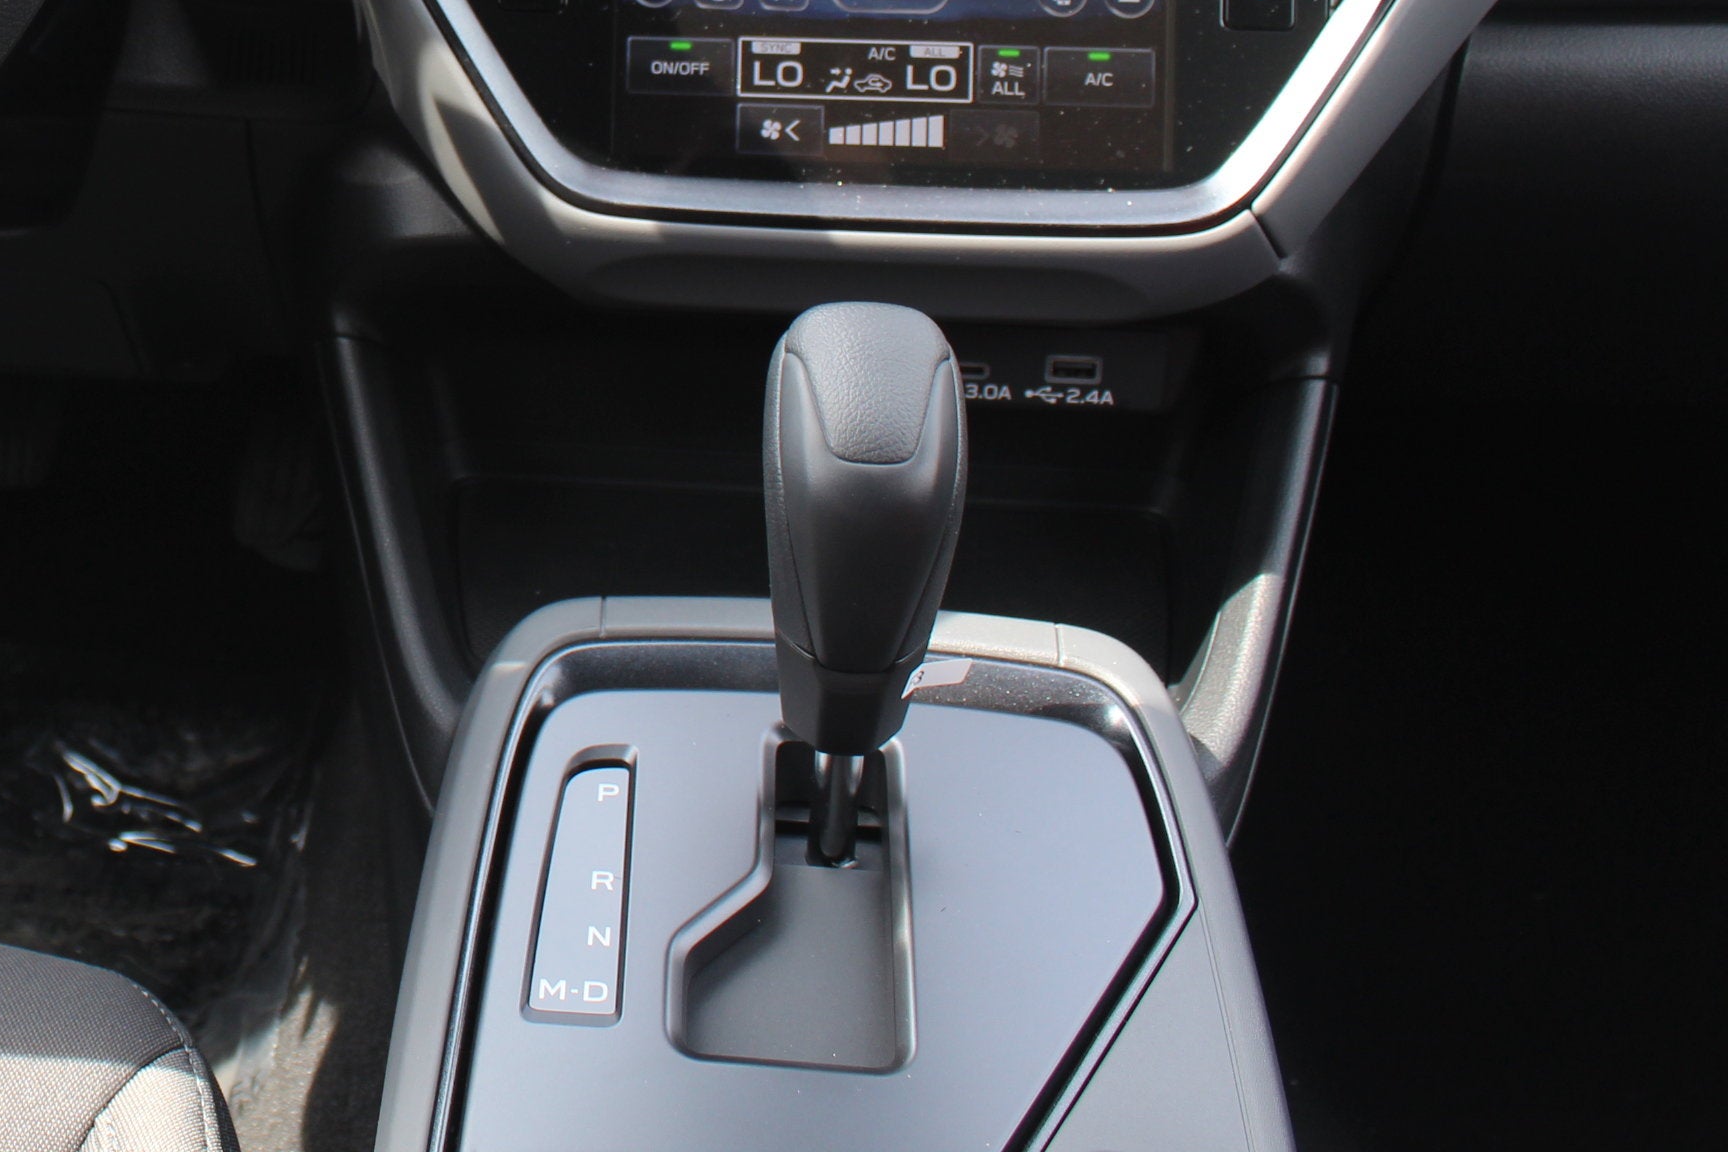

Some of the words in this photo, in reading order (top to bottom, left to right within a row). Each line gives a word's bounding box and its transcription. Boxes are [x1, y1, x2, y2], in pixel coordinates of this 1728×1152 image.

[868, 47, 896, 61] A/C
[651, 61, 710, 76] ON/OFF
[753, 61, 803, 88] LO
[906, 65, 957, 91] LO
[1085, 73, 1114, 87] A/C
[991, 81, 1026, 97] ALL
[966, 384, 1012, 400] 3.0A
[1066, 388, 1114, 405] 2.4A
[597, 783, 620, 802] P
[591, 870, 614, 891] R
[587, 926, 611, 947] N
